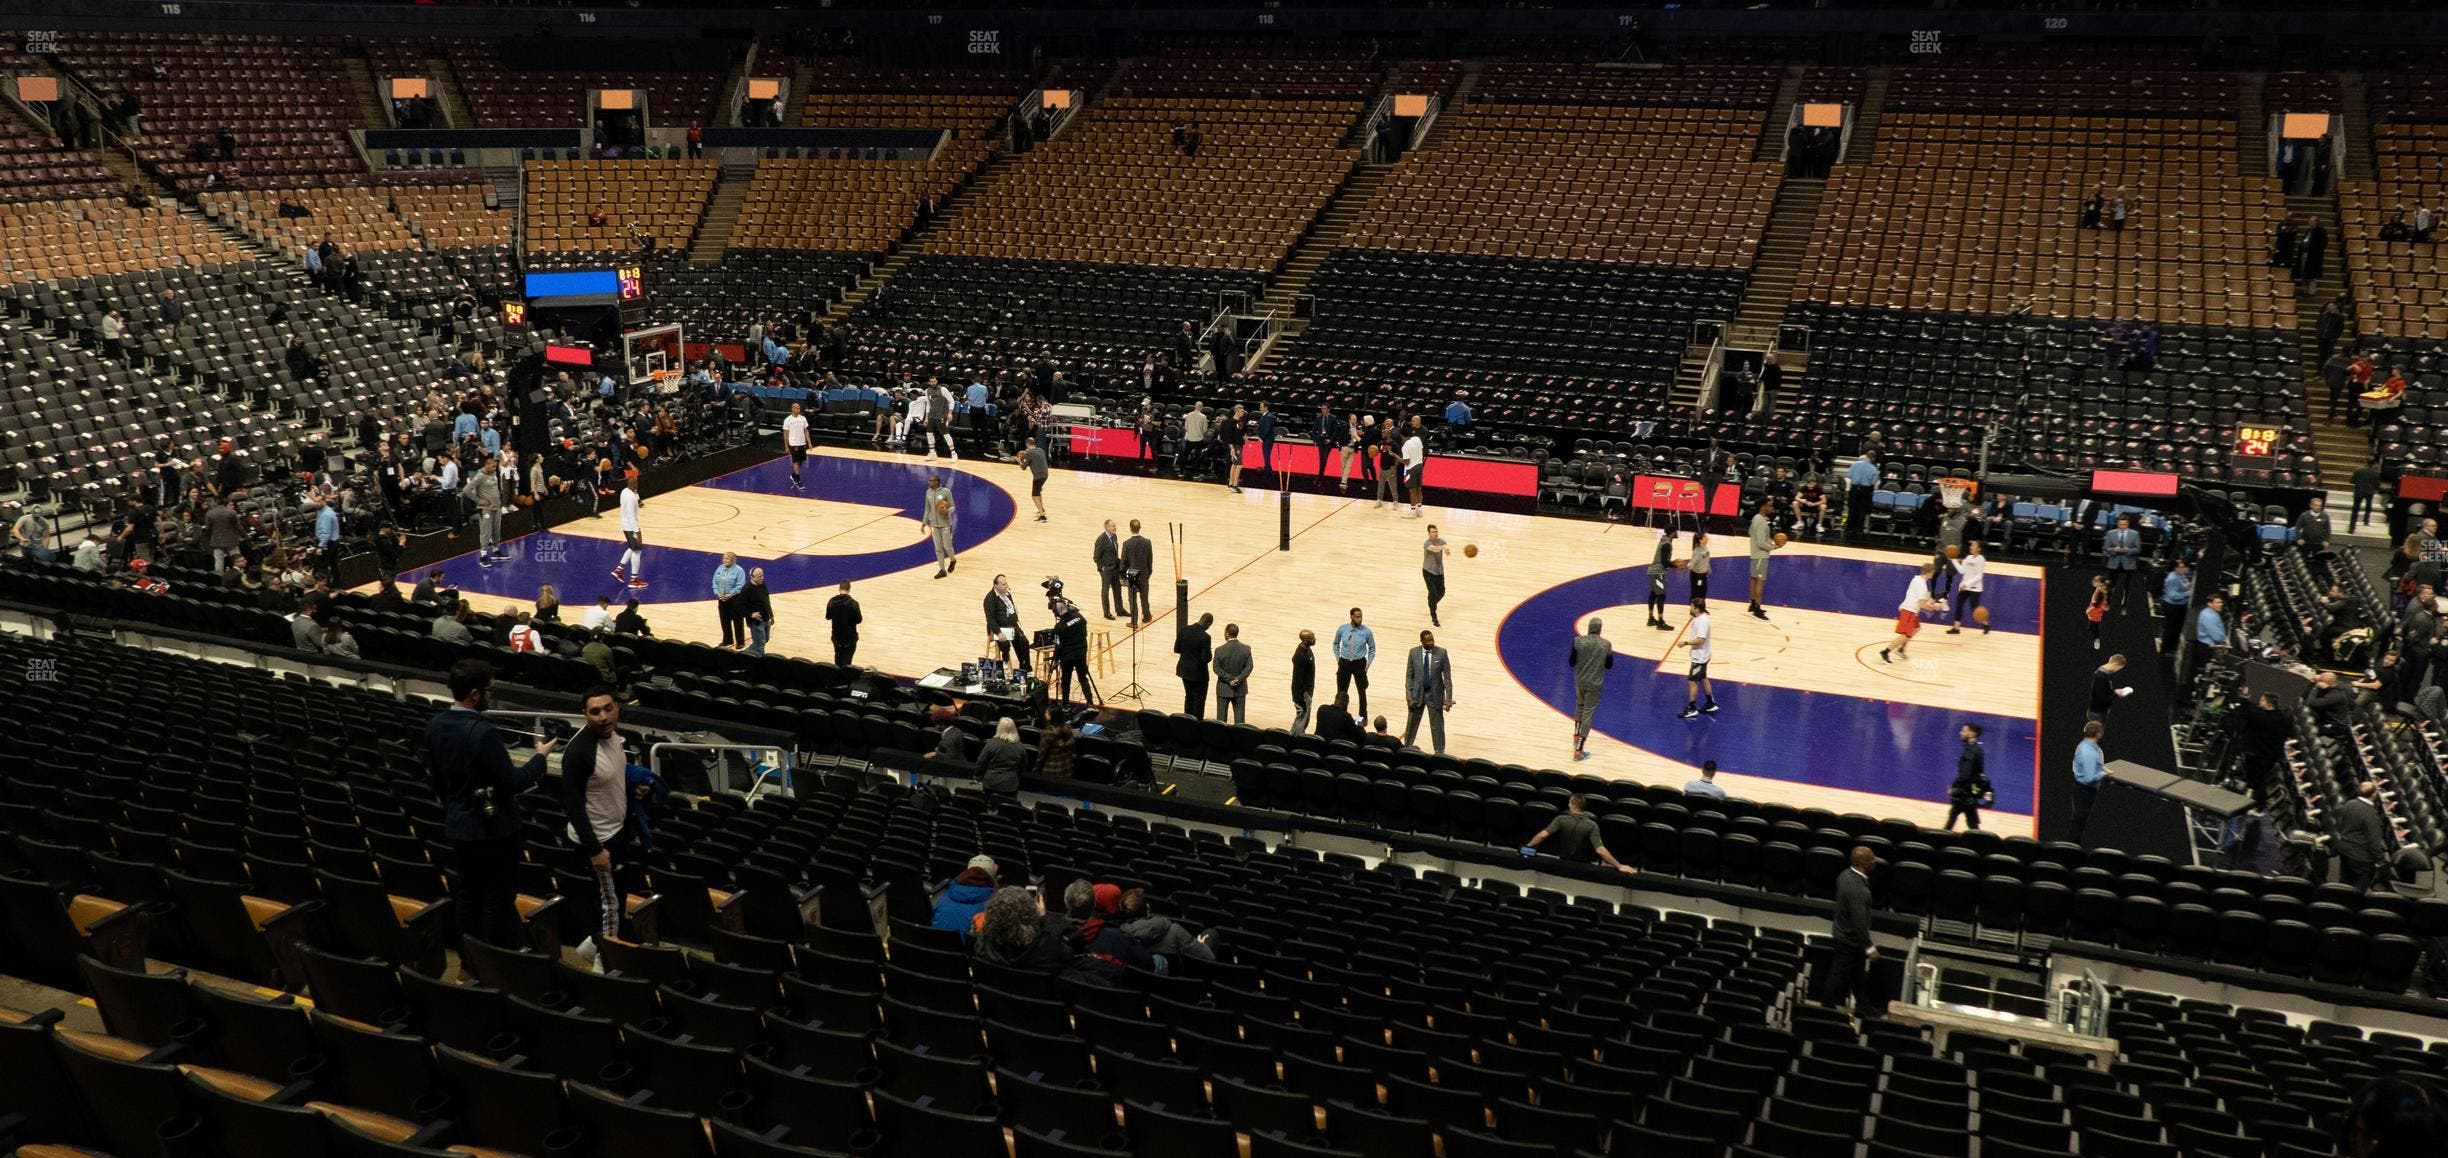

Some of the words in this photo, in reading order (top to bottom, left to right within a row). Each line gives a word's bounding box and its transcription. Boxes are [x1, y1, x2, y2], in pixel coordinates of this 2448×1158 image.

[161, 3, 181, 15] 115
[579, 12, 595, 23] 116
[927, 15, 943, 25] 117
[1258, 14, 1273, 24] 118
[1618, 15, 1633, 26] 11
[2044, 17, 2067, 29] 120
[623, 280, 640, 298] 24
[509, 313, 521, 324] 24
[2245, 440, 2268, 455] 24
